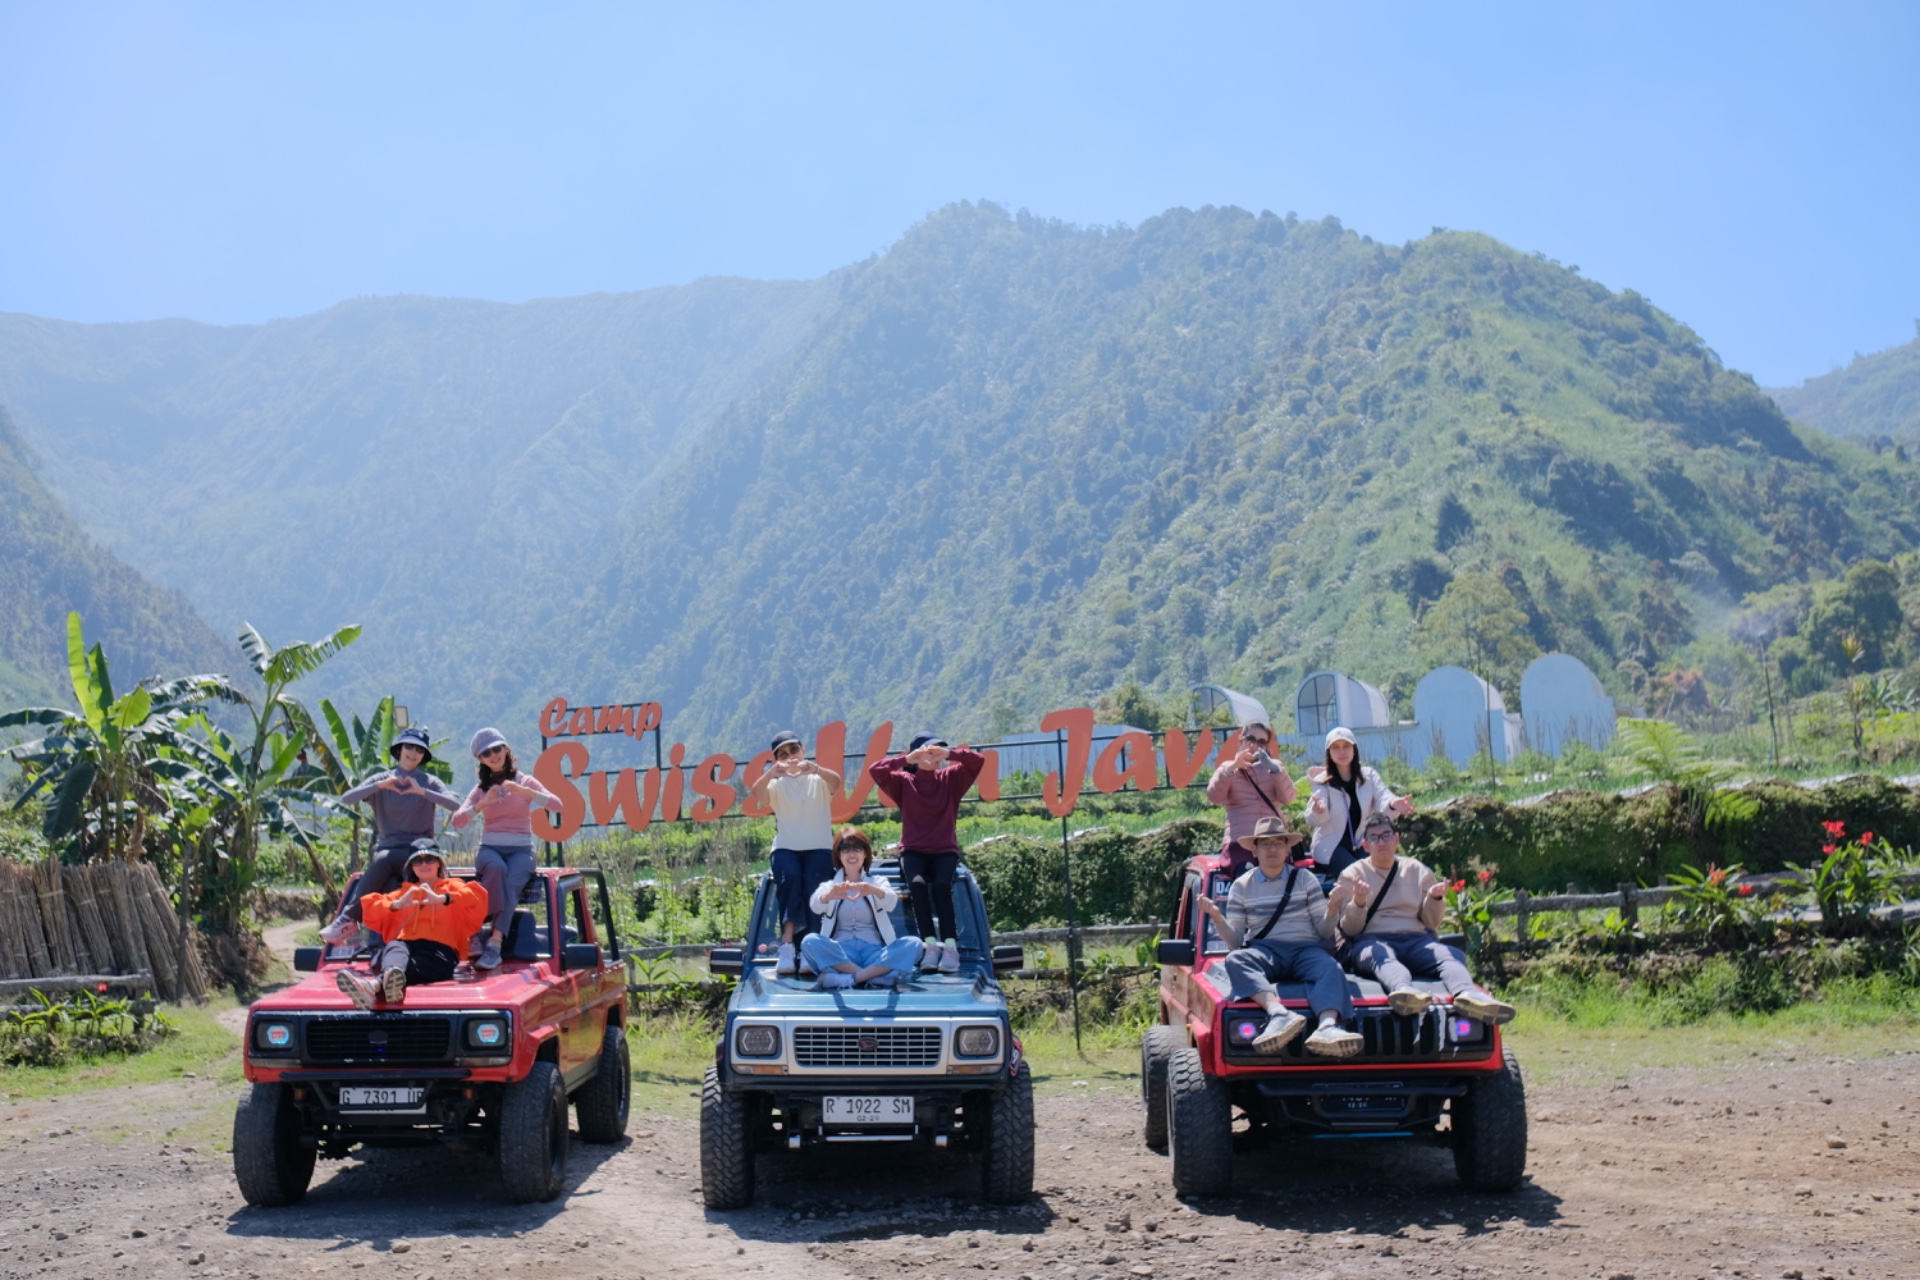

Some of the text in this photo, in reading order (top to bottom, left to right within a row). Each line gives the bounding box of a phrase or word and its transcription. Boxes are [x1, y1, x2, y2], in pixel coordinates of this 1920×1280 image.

[539, 697, 662, 741] Camp
[531, 741, 775, 842] Swiss
[826, 1098, 911, 1114] R 1922 SM
